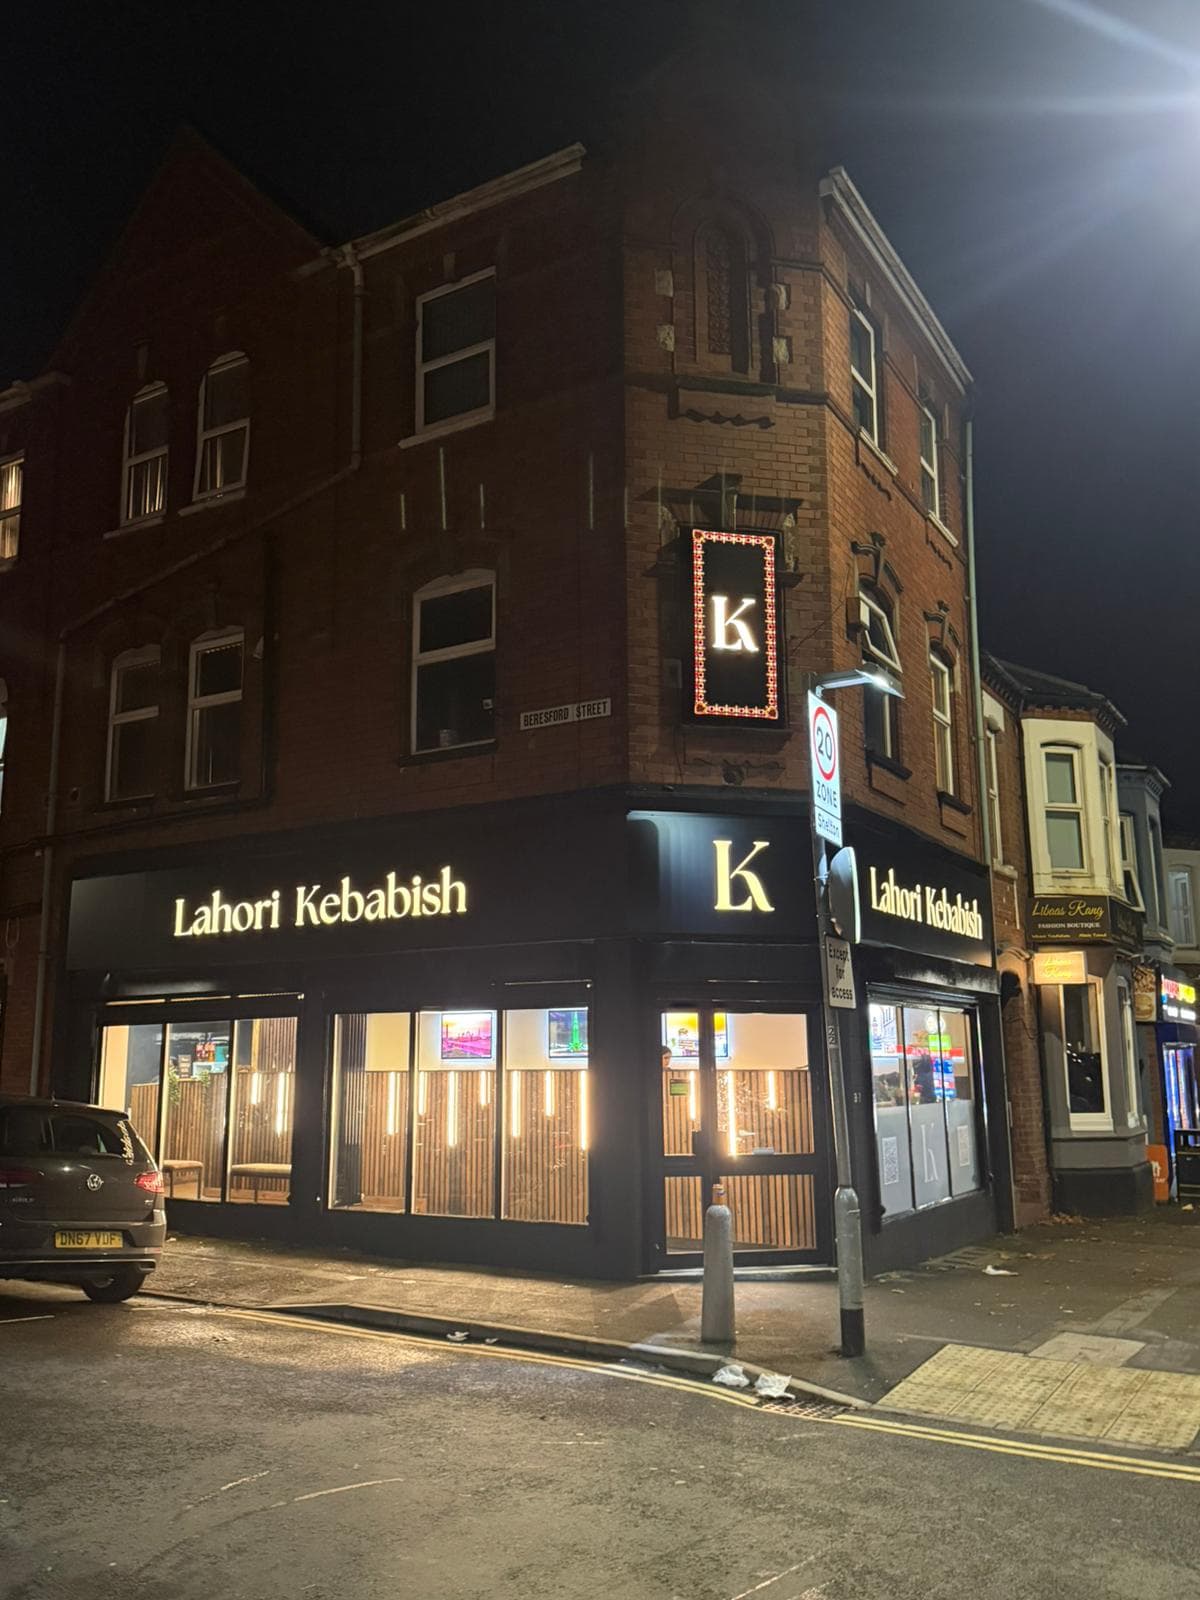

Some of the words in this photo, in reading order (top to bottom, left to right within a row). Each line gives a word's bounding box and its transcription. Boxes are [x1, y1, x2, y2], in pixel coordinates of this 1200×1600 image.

[712, 595, 760, 652] K
[523, 707, 569, 727] BERESFORD
[575, 701, 608, 718] STREET
[816, 725, 833, 761] 20
[816, 779, 838, 809] ZONE
[817, 812, 840, 839] Shelton
[713, 840, 776, 912] K
[174, 889, 281, 937] Lahori
[294, 865, 467, 927] Kebabish
[869, 866, 923, 923] Lahori
[924, 886, 983, 941] Kebabish
[828, 943, 850, 962] Except
[835, 963, 846, 979] for
[831, 986, 853, 1001] access
[60, 1231, 91, 1246] DN67
[94, 1231, 117, 1246] VDF
